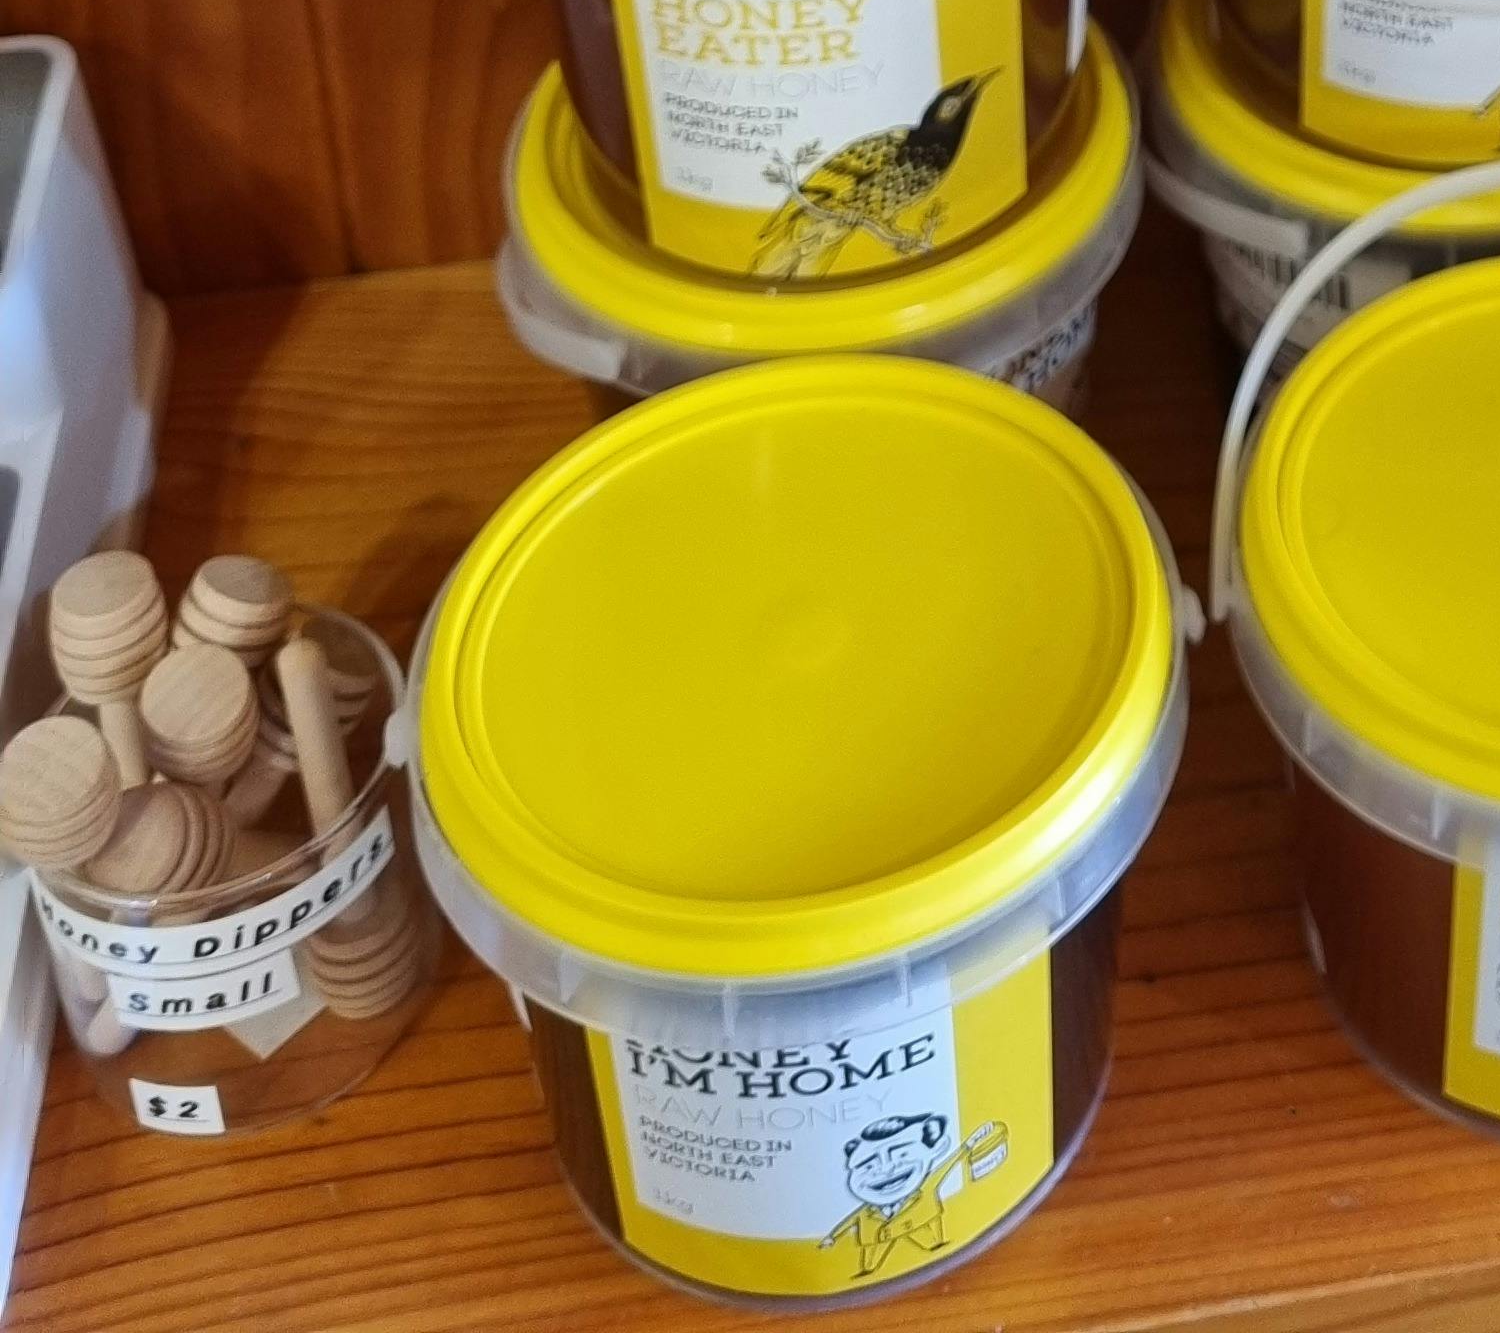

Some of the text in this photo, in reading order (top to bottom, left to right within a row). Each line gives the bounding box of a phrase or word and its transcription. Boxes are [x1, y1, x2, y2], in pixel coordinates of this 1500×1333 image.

[655, 21, 862, 68] EATER
[193, 834, 384, 960] Dippers
[129, 972, 274, 1015] Small
[627, 1033, 937, 1099] I'M HOME
[148, 1096, 200, 1120] $2
[738, 1086, 894, 1130] HONEY
[639, 1114, 794, 1153] PRODUCED IN
[640, 1130, 779, 1167] NORTH EAST
[644, 1146, 756, 1182] VICTORIA
